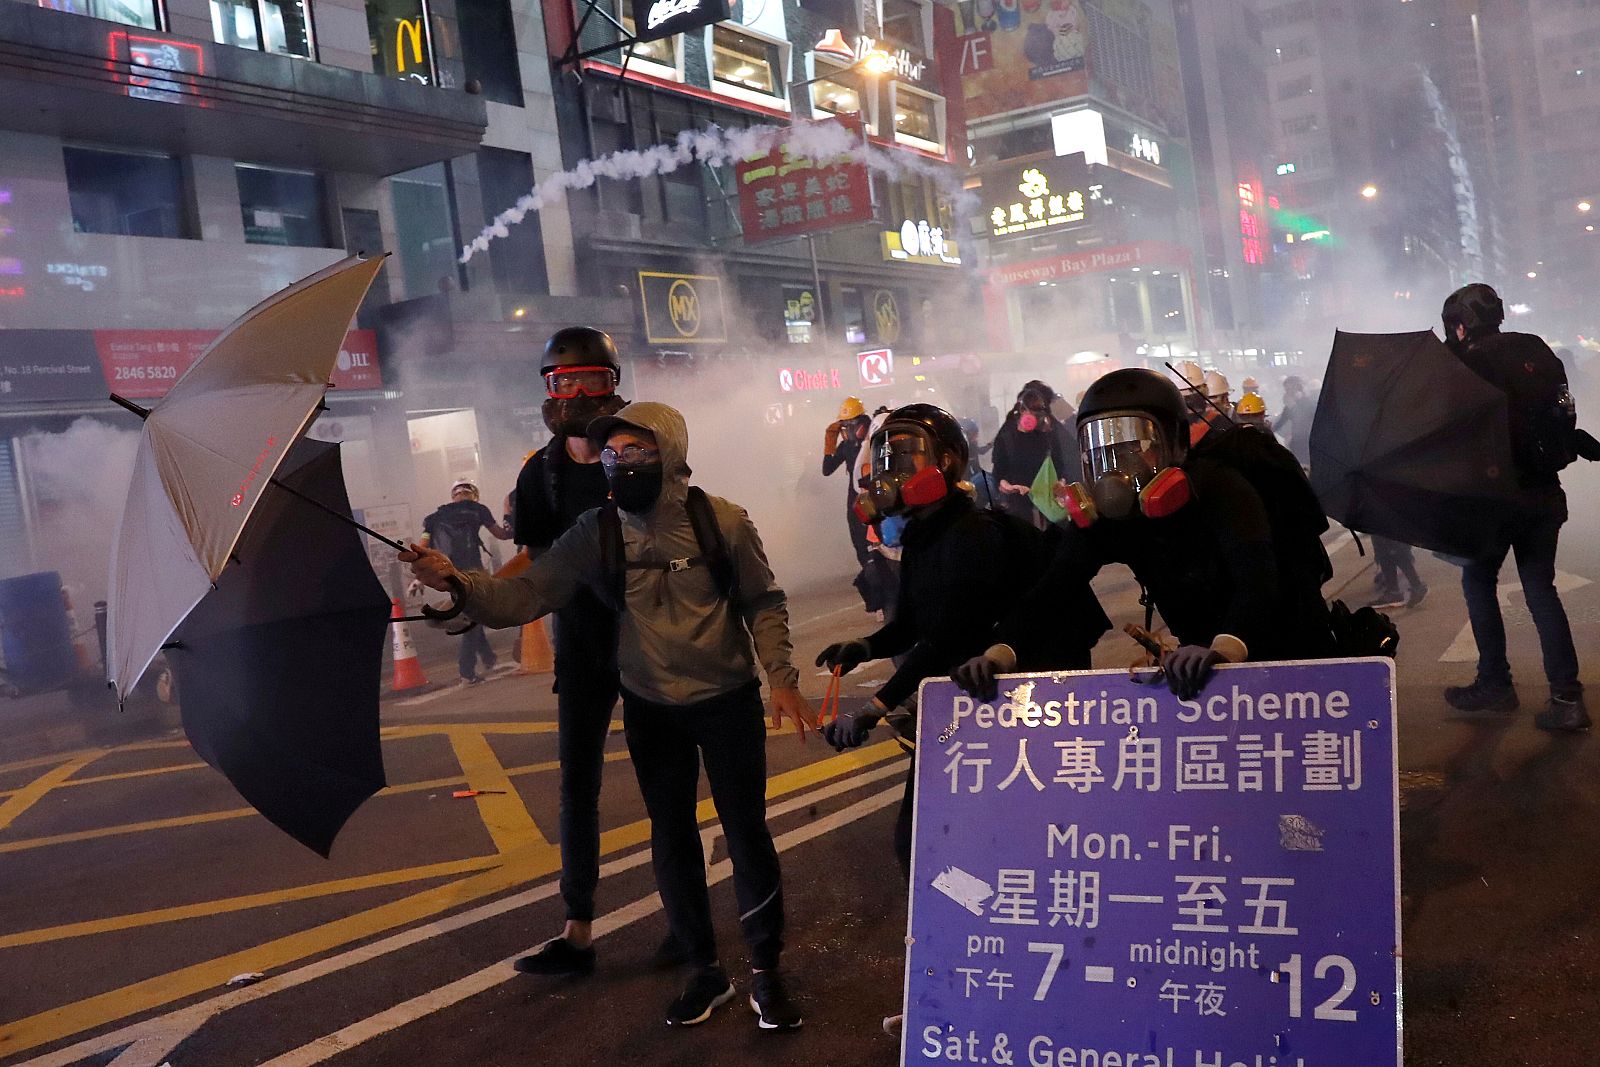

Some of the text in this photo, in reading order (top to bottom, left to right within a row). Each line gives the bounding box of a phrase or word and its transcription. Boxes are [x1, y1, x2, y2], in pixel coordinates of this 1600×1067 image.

[989, 263, 1057, 286] Causeway
[1061, 258, 1088, 273] Bay
[1091, 252, 1130, 268] Plaza
[671, 295, 698, 321] MX
[115, 365, 177, 380] 2846 5820
[351, 353, 371, 367] JLL
[864, 356, 885, 383] K
[793, 368, 828, 390] Circle
[830, 367, 842, 388] K
[953, 685, 1350, 728] Pedestrian Scheme
[944, 730, 1362, 793] 行人專用區計劃
[989, 868, 1299, 936] 星期一至五
[967, 934, 1005, 957] pm
[1129, 938, 1260, 973] midnight
[955, 968, 1014, 1001] 下午
[1028, 942, 1065, 1001] 7
[1280, 953, 1358, 1022] 12
[1159, 979, 1227, 1017] 午夜
[1028, 1035, 1174, 1067] General
